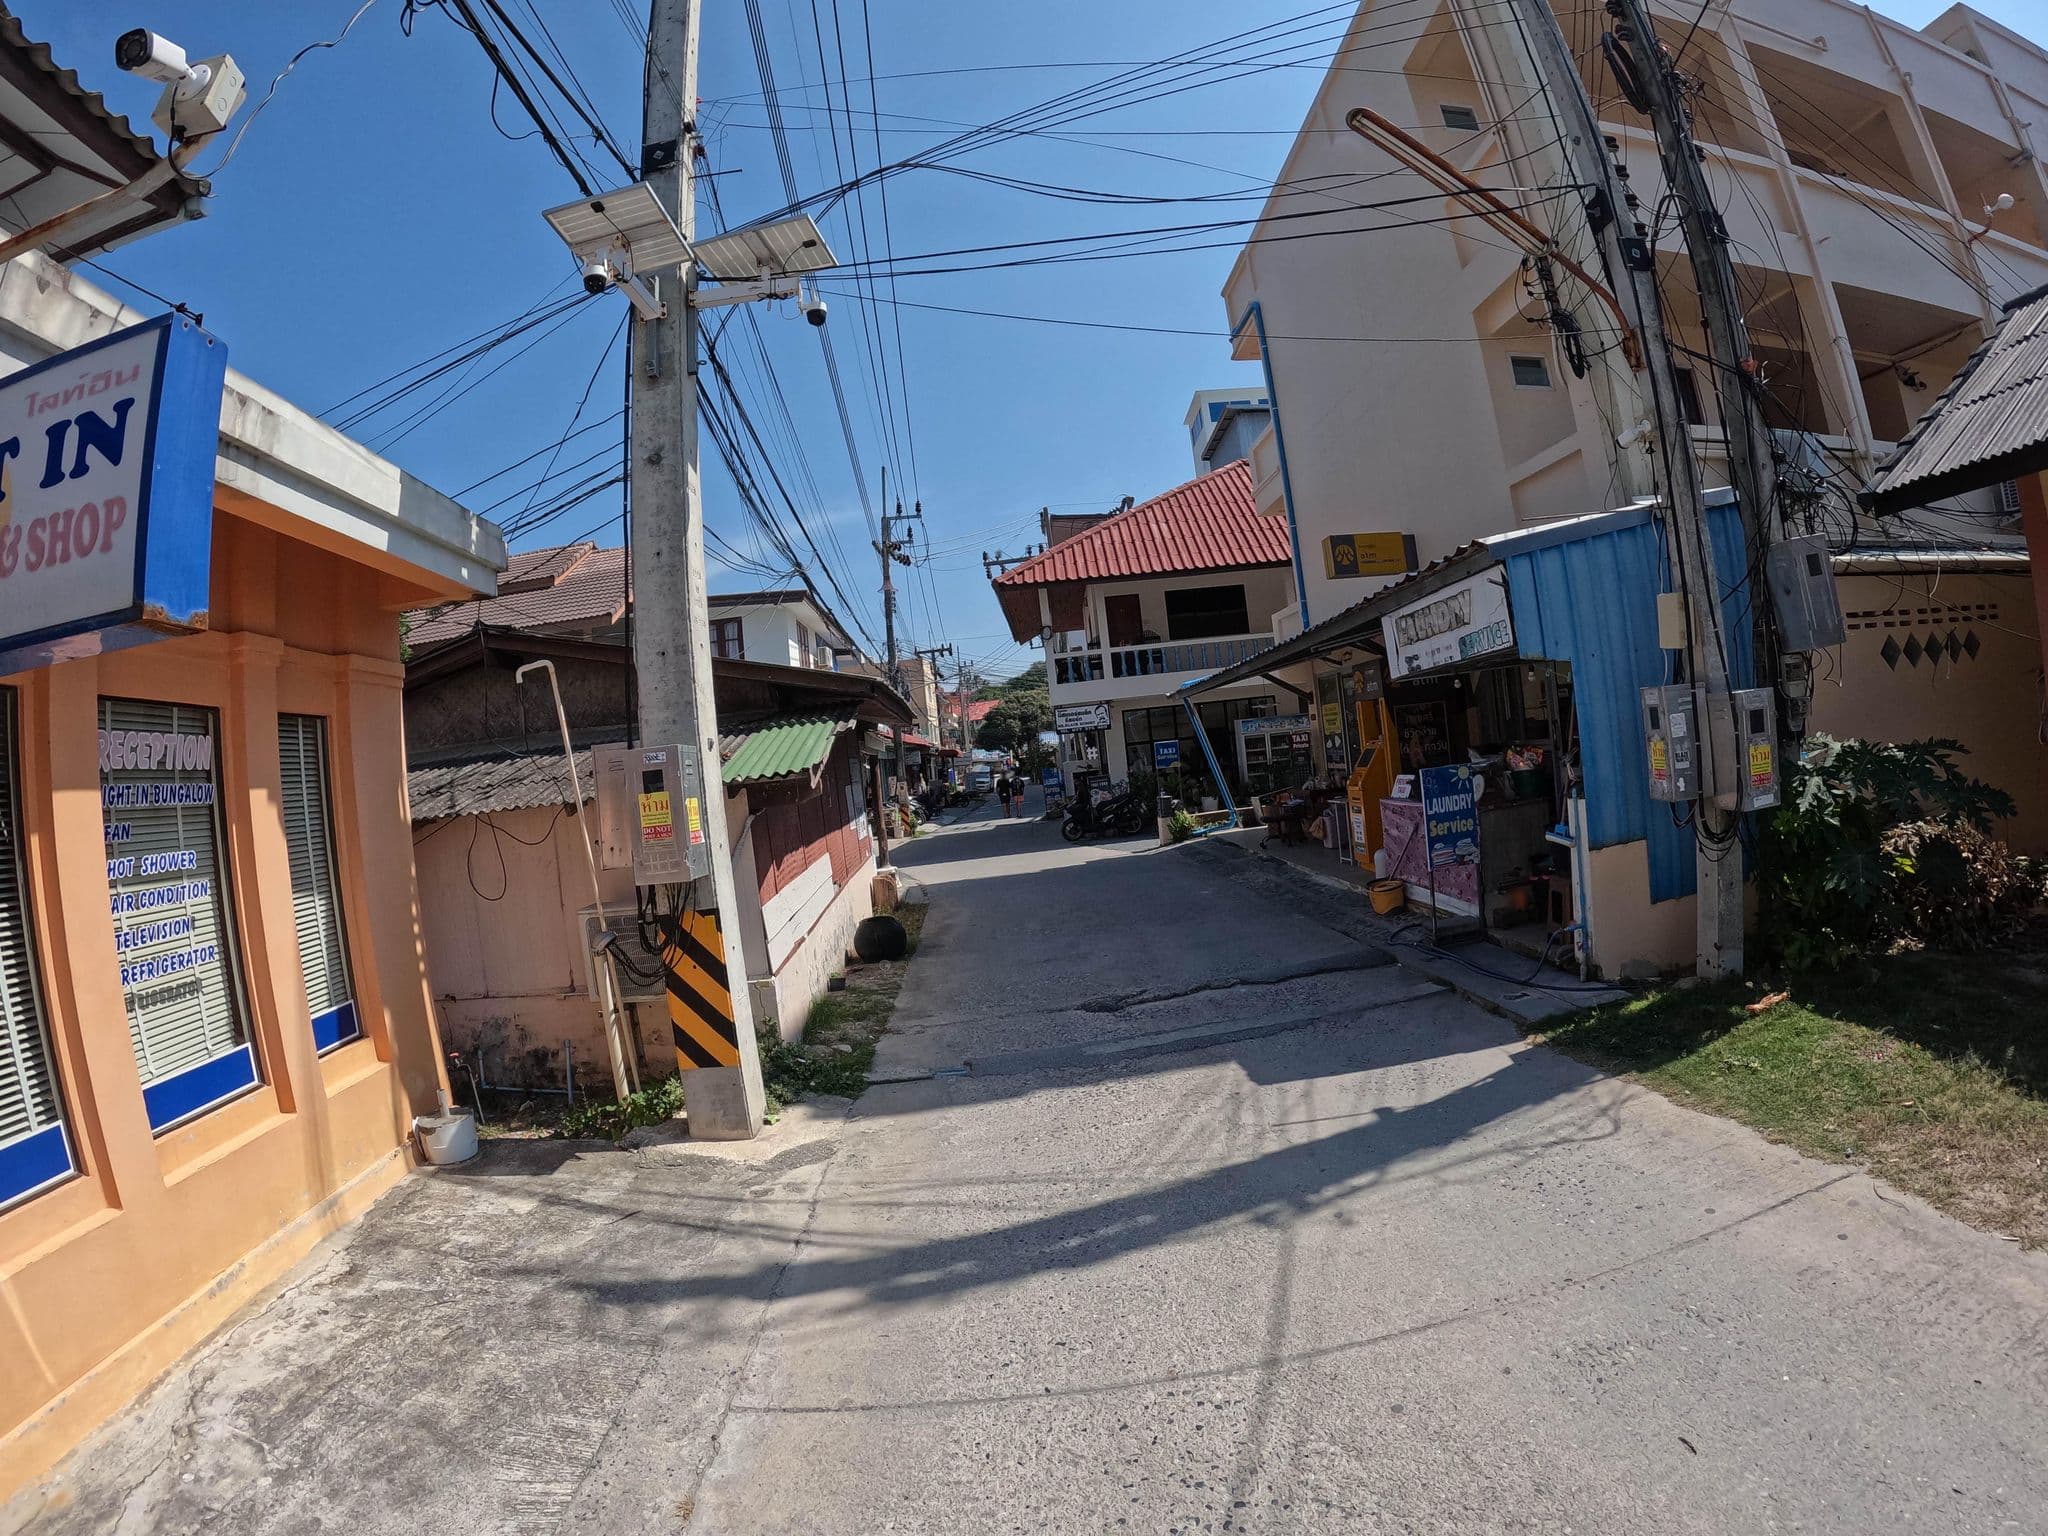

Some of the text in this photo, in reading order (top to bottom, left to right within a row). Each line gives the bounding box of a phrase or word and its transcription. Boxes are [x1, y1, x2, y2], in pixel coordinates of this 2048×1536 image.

[40, 397, 135, 489] IN
[1458, 619, 1510, 661] SERVICE
[1292, 733, 1309, 743] TAXI
[97, 729, 212, 772] RECEPTION
[1159, 747, 1176, 755] TAXI
[102, 783, 214, 807] IGHT IN BUNGALOW
[641, 794, 669, 813] ห้าม
[1426, 792, 1473, 815] LAUNDRY
[104, 823, 131, 841] FAN
[643, 825, 672, 835] DO NOT
[1429, 815, 1474, 837] Service
[107, 851, 197, 878] HOT SHOWER
[111, 881, 208, 914] AIR CONDITION
[115, 916, 190, 951] TELEVISION
[120, 945, 215, 987] REFRIGERATOR
